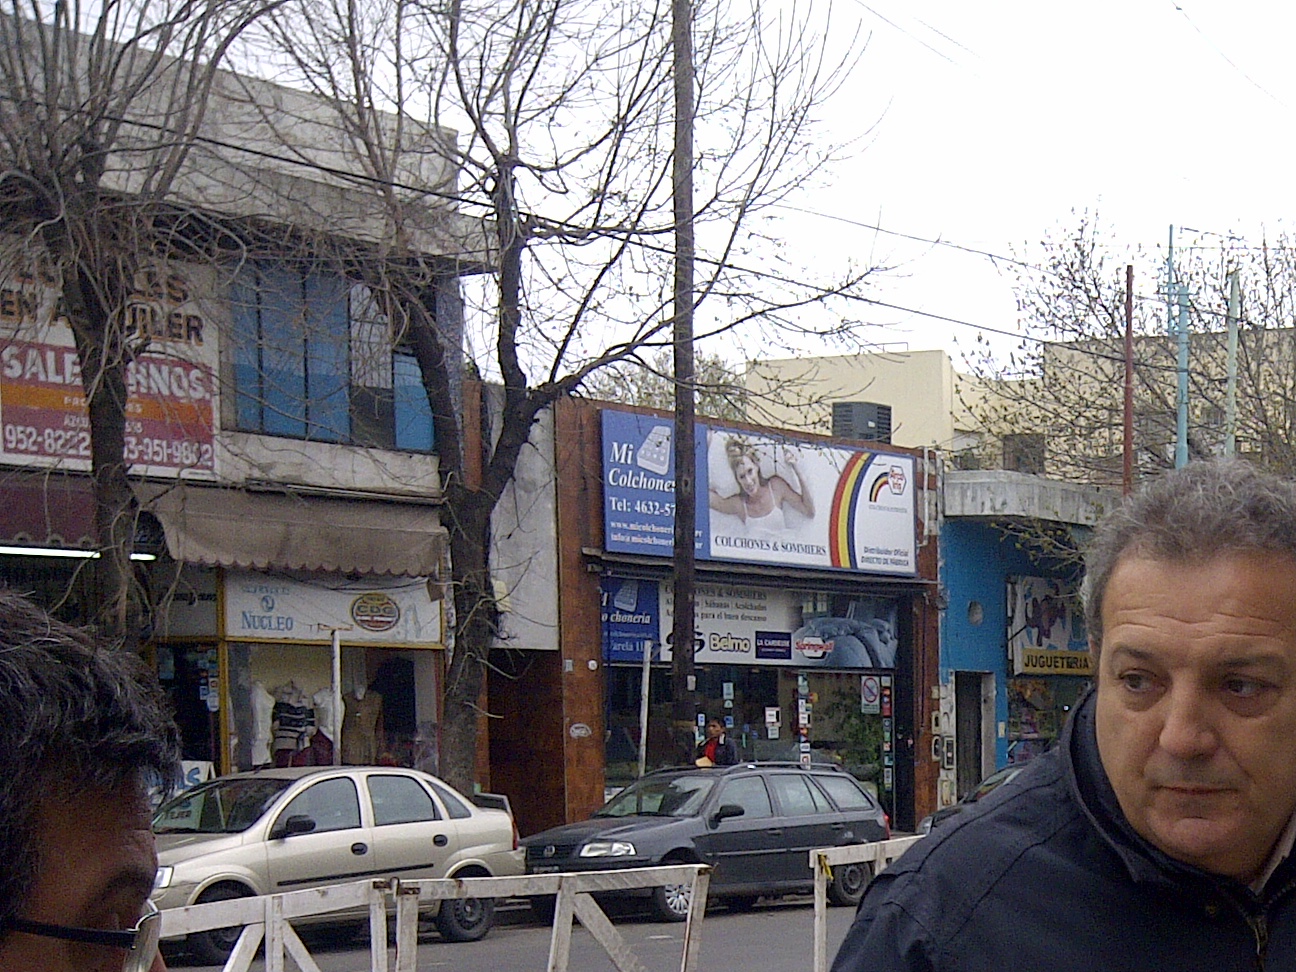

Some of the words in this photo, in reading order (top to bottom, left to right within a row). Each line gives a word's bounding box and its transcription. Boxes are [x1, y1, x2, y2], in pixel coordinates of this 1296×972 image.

[609, 441, 634, 465] Mi
[610, 496, 631, 513] Tel:
[715, 535, 770, 551] COLCHONES
[772, 541, 779, 552] &
[781, 542, 827, 556] SOMMIERS
[709, 633, 750, 653] Belmo
[1024, 654, 1090, 670] JUGUETERIA
